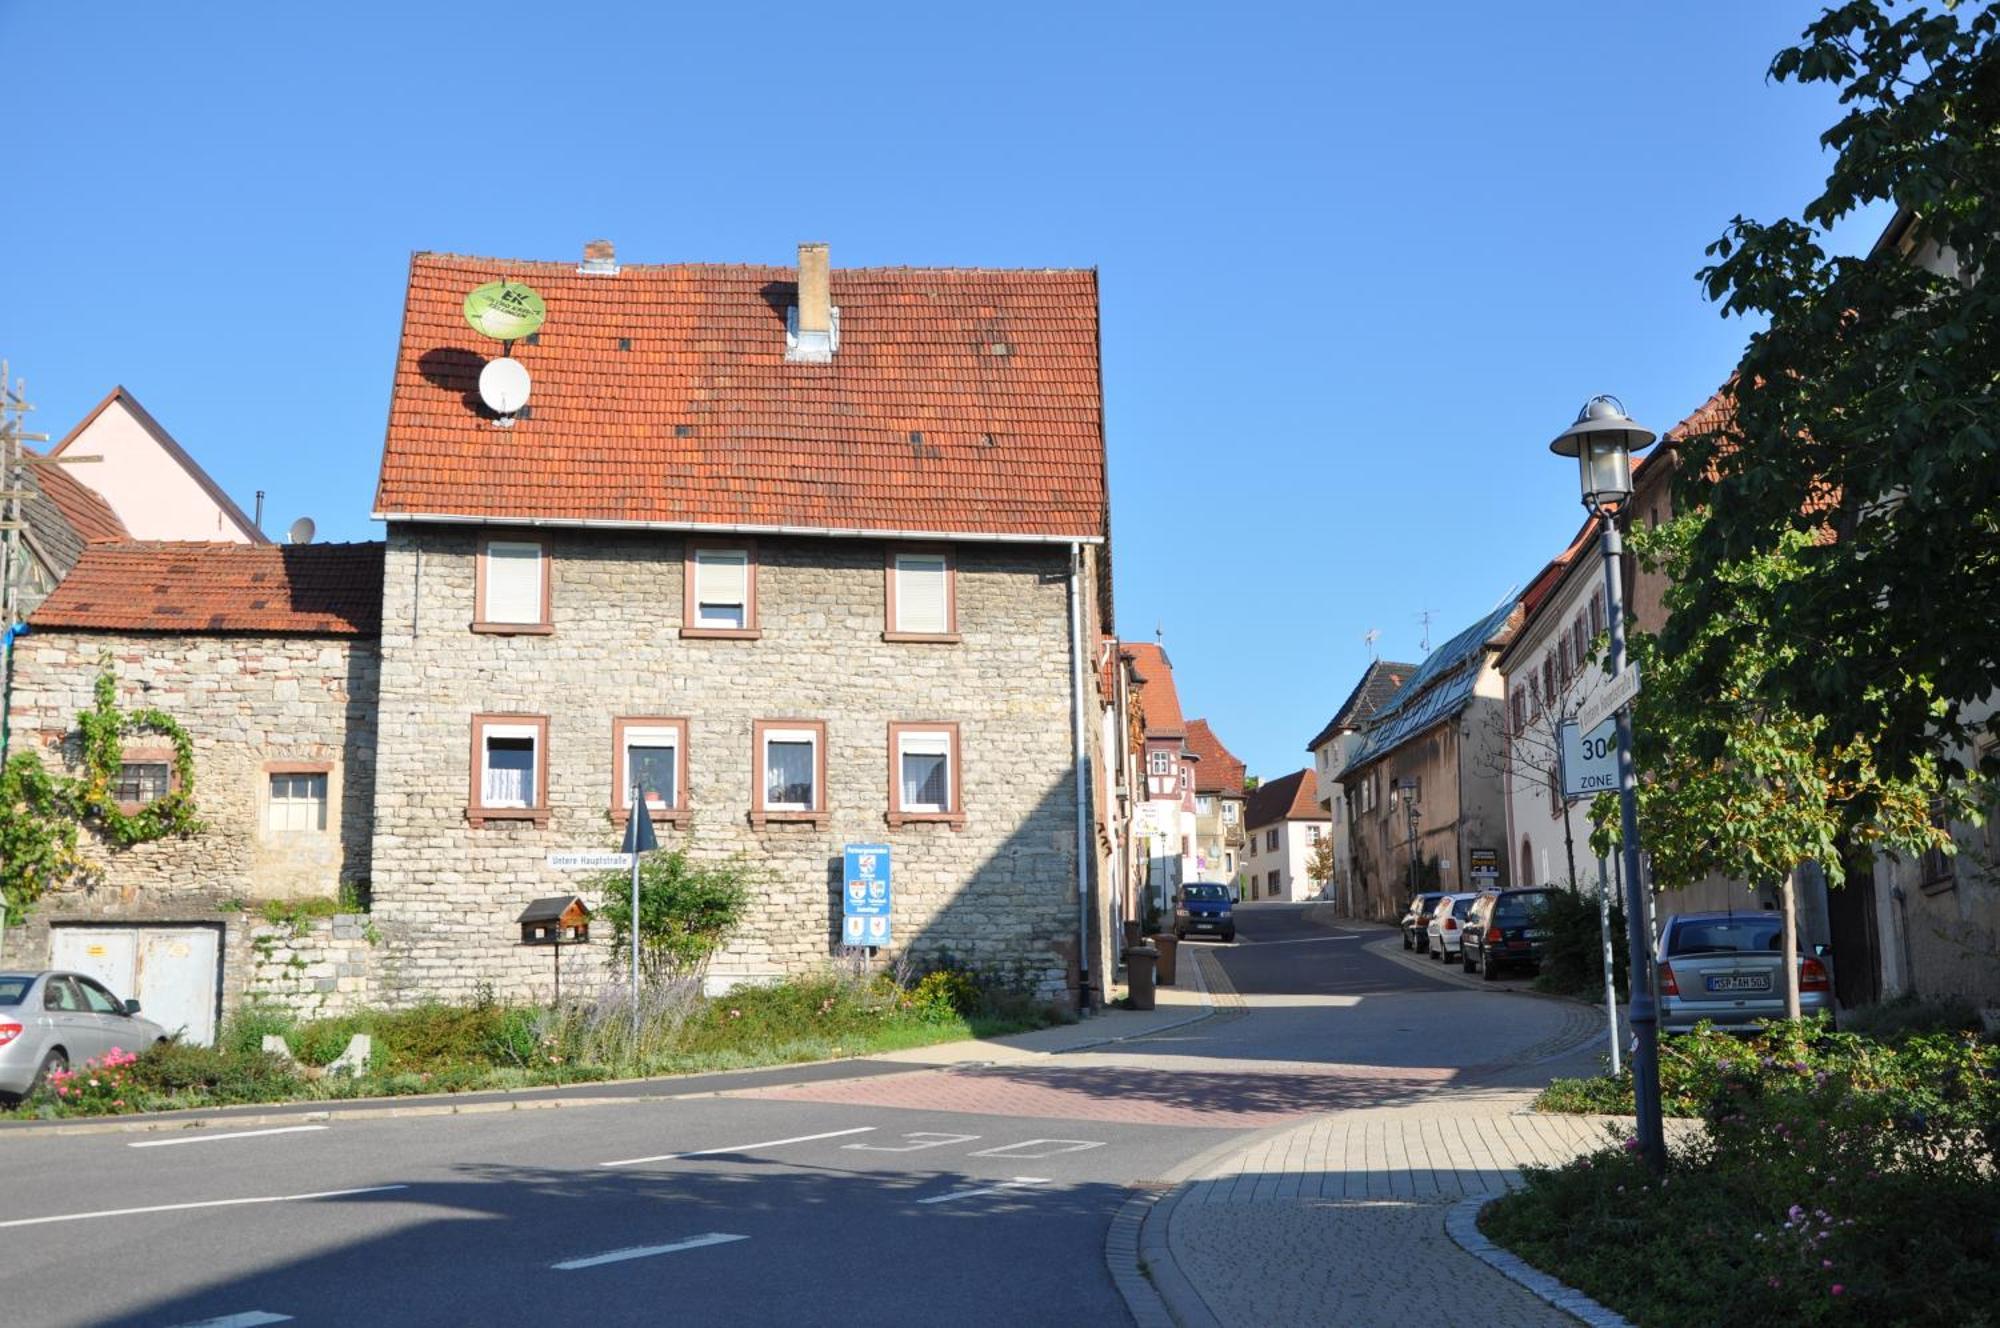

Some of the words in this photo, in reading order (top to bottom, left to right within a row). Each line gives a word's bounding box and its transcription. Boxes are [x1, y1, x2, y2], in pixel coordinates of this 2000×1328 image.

[502, 289, 530, 305] EK
[1582, 738, 1607, 760] 30
[1581, 774, 1613, 789] ZONE
[552, 855, 577, 865] Untere
[580, 855, 627, 866] Hauptstraße
